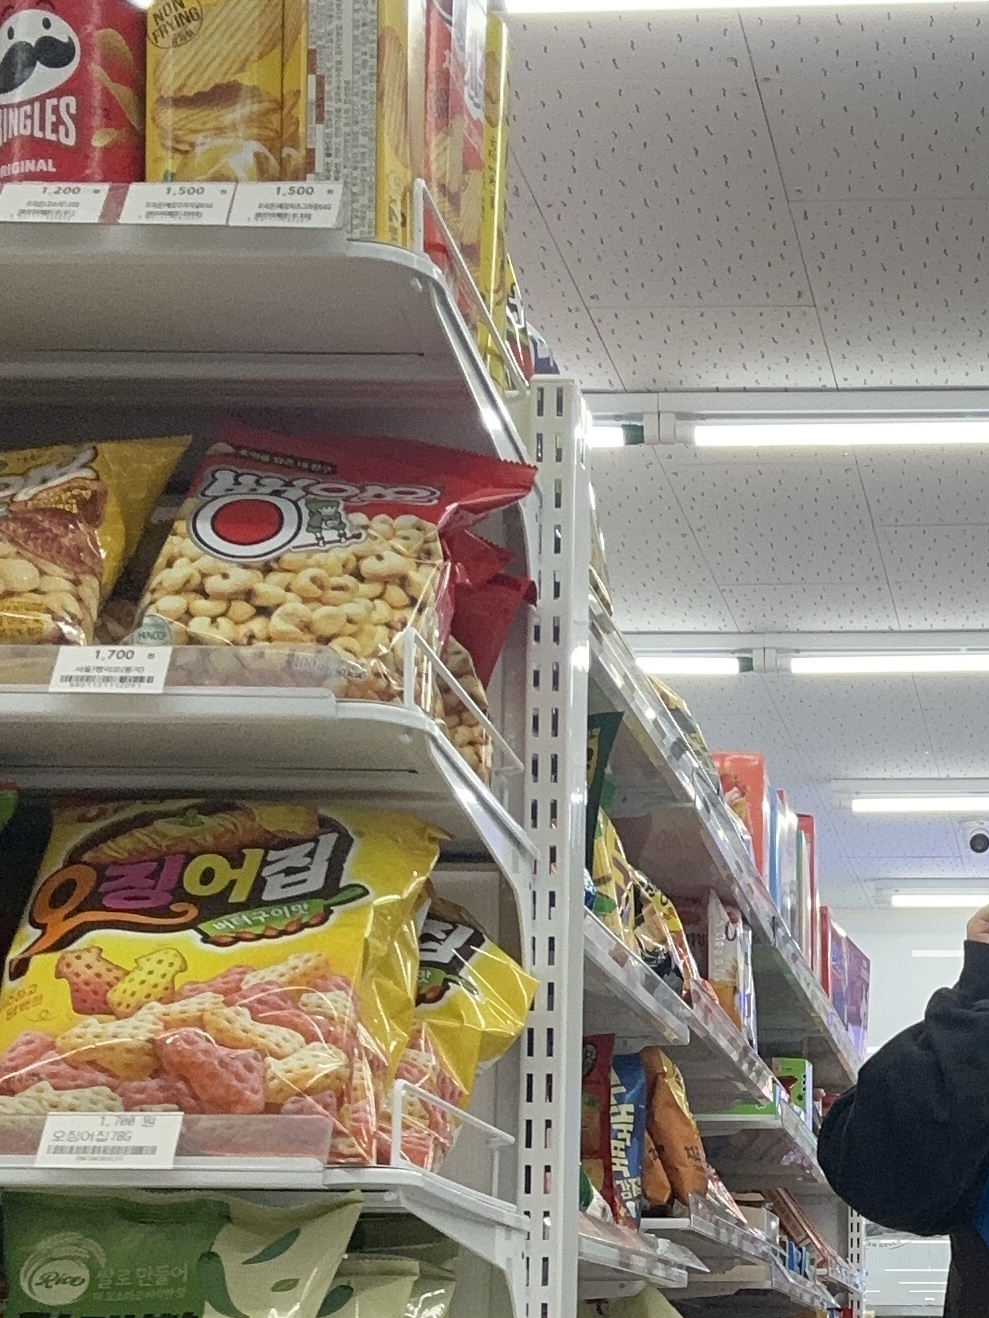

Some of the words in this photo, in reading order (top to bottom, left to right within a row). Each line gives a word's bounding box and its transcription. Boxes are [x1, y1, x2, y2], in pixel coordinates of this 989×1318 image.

[153, 0, 186, 25] NON
[152, 6, 199, 43] FRYING
[0, 158, 56, 179] RIGINAL
[165, 186, 205, 196] 1,500
[275, 186, 315, 196] 1,500
[94, 649, 135, 661] 1,700
[8, 832, 338, 976] 오징어집
